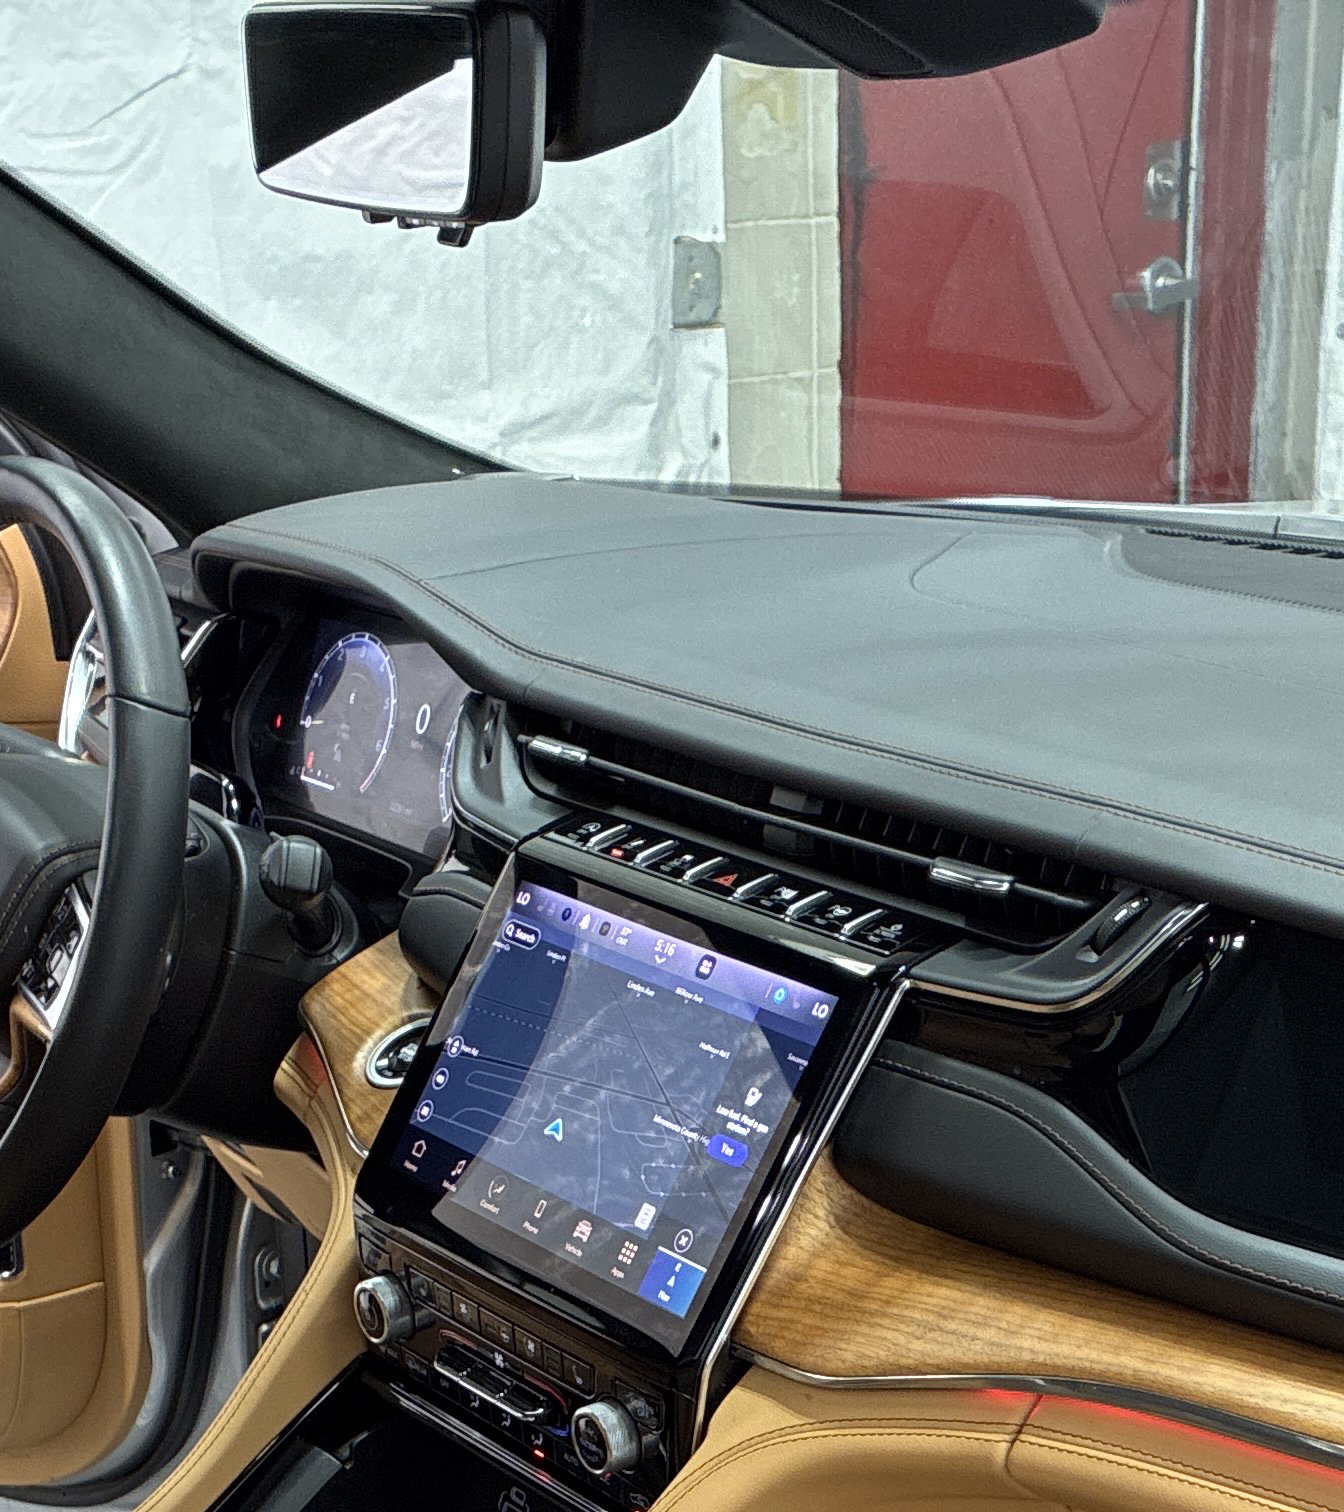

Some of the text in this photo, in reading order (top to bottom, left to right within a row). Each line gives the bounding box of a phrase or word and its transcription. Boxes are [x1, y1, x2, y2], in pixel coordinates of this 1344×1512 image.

[416, 703, 431, 734] 0
[516, 890, 531, 906] LO
[515, 927, 537, 945] Search
[654, 938, 678, 956] 5:16
[811, 1001, 830, 1019] LO
[720, 1142, 734, 1157] Yes
[522, 1220, 540, 1236] Phone
